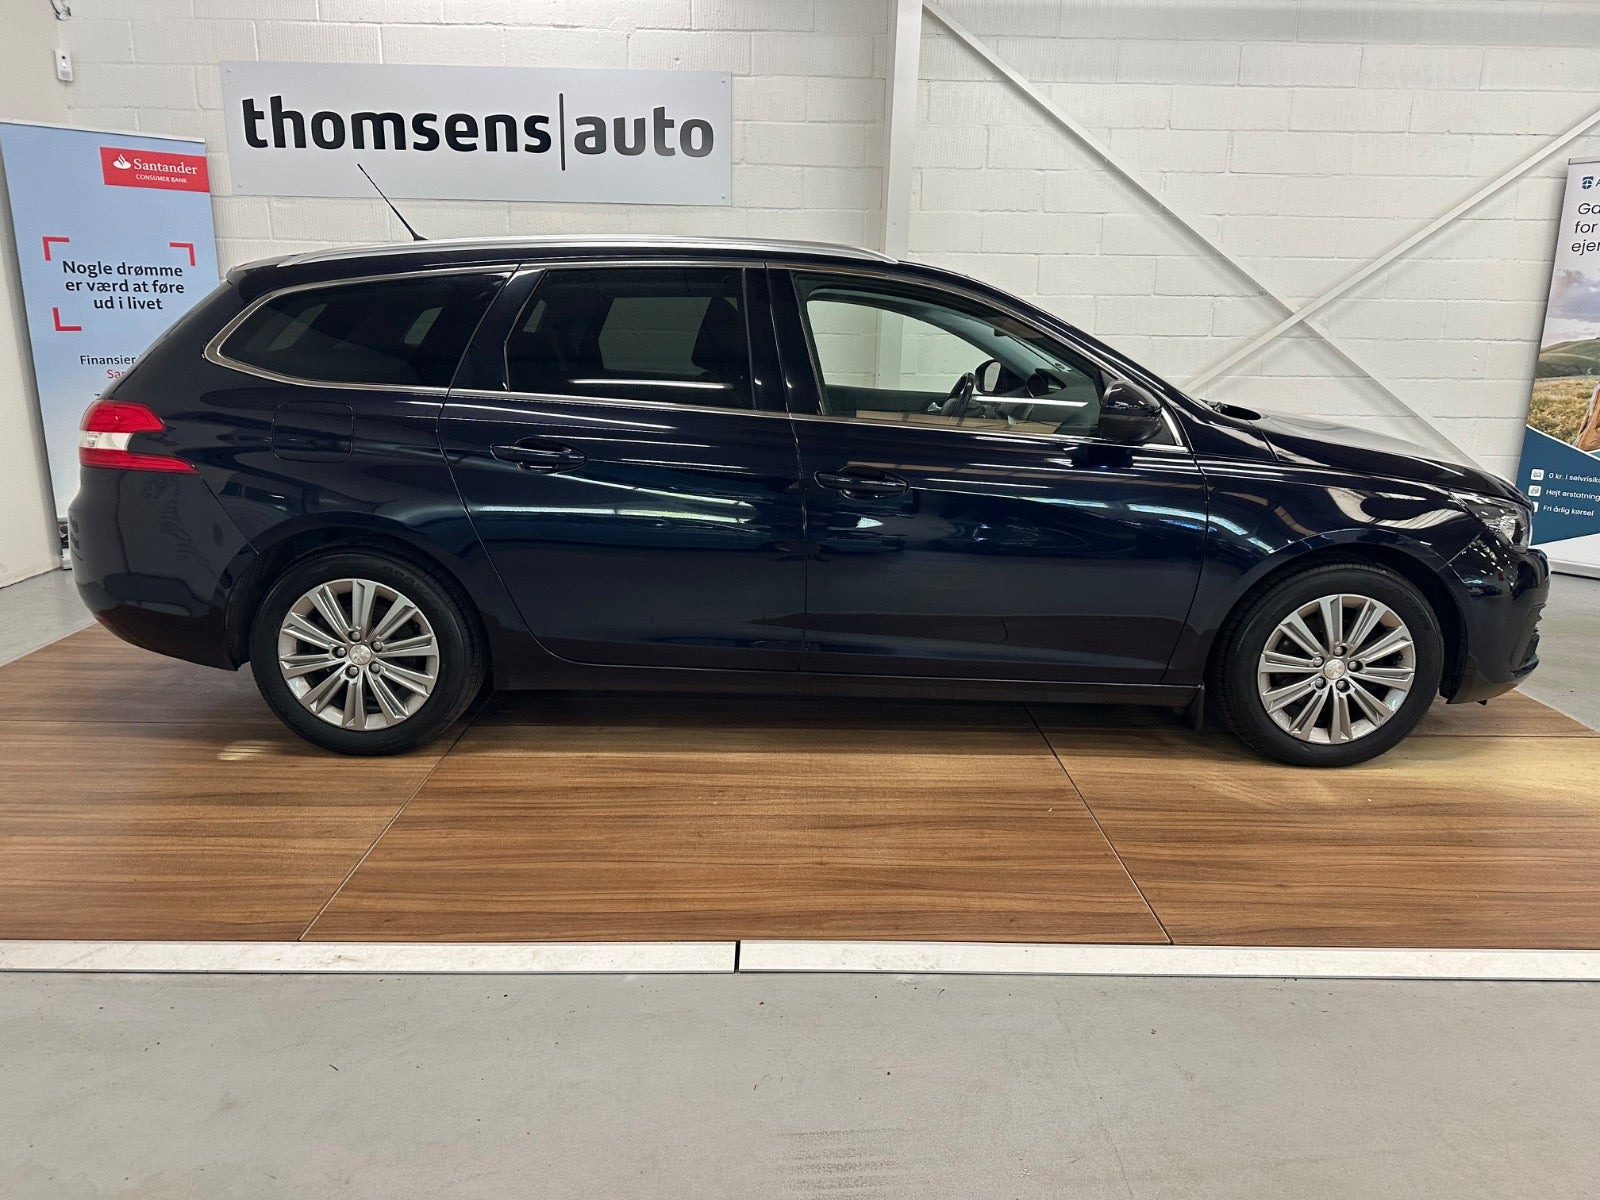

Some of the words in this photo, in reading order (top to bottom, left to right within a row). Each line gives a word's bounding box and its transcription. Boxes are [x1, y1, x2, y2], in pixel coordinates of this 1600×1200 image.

[241, 95, 551, 154] thomsens
[573, 106, 714, 158] auto
[133, 158, 197, 174] Santander
[136, 174, 170, 182] CONSUMER
[1575, 221, 1598, 233] for
[62, 260, 112, 278] Nogle
[117, 261, 183, 277] drømme
[65, 281, 82, 292] er
[87, 279, 129, 293] værd
[133, 281, 148, 293] at
[151, 280, 185, 294] føre
[93, 296, 115, 309] ud
[118, 296, 124, 309] i
[127, 296, 163, 310] livet
[1546, 488, 1561, 497] Højt
[1553, 505, 1570, 515] årlig
[1572, 508, 1594, 517] kørsel
